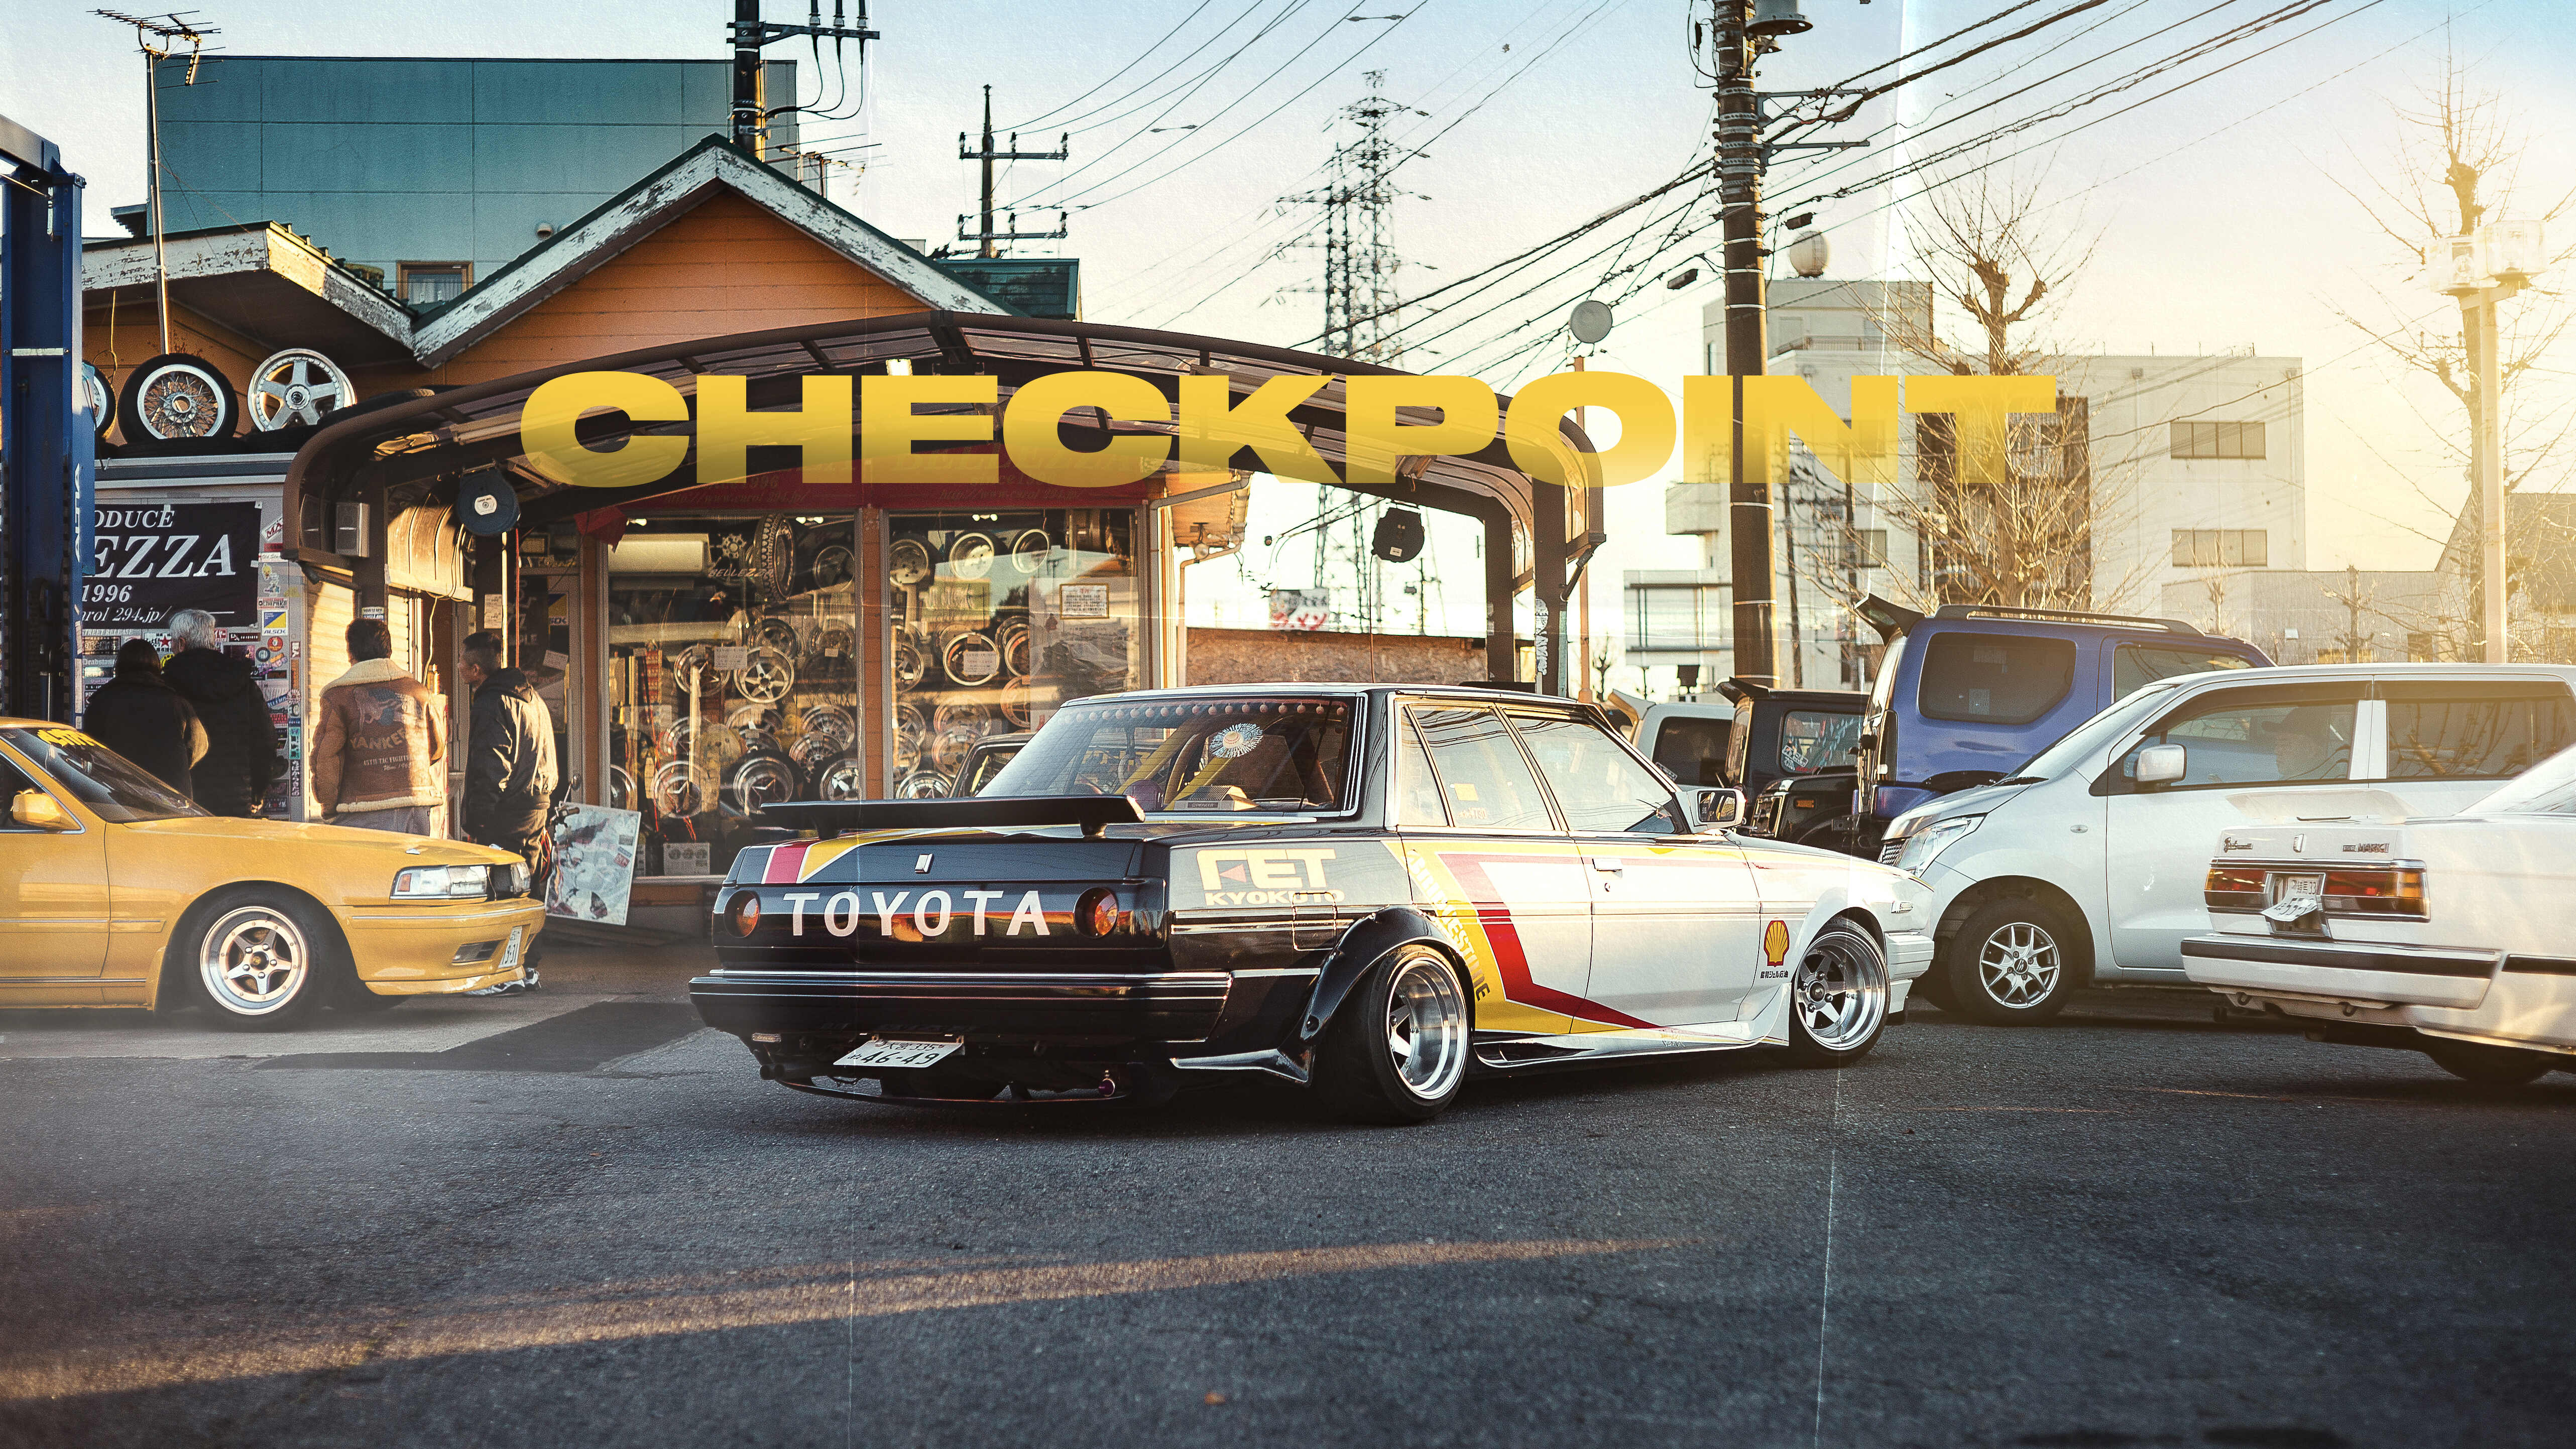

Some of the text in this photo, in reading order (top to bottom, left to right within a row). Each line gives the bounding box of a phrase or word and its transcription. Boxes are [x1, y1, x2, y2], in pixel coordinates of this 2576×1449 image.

[82, 585, 132, 602] 1996
[1196, 848, 1336, 891] FET
[1205, 889, 1345, 906] KYOKUTO
[783, 890, 1050, 937] TOYOTA
[1760, 970, 1789, 979] 昭和シェル石油
[860, 1051, 940, 1065] 46-49
